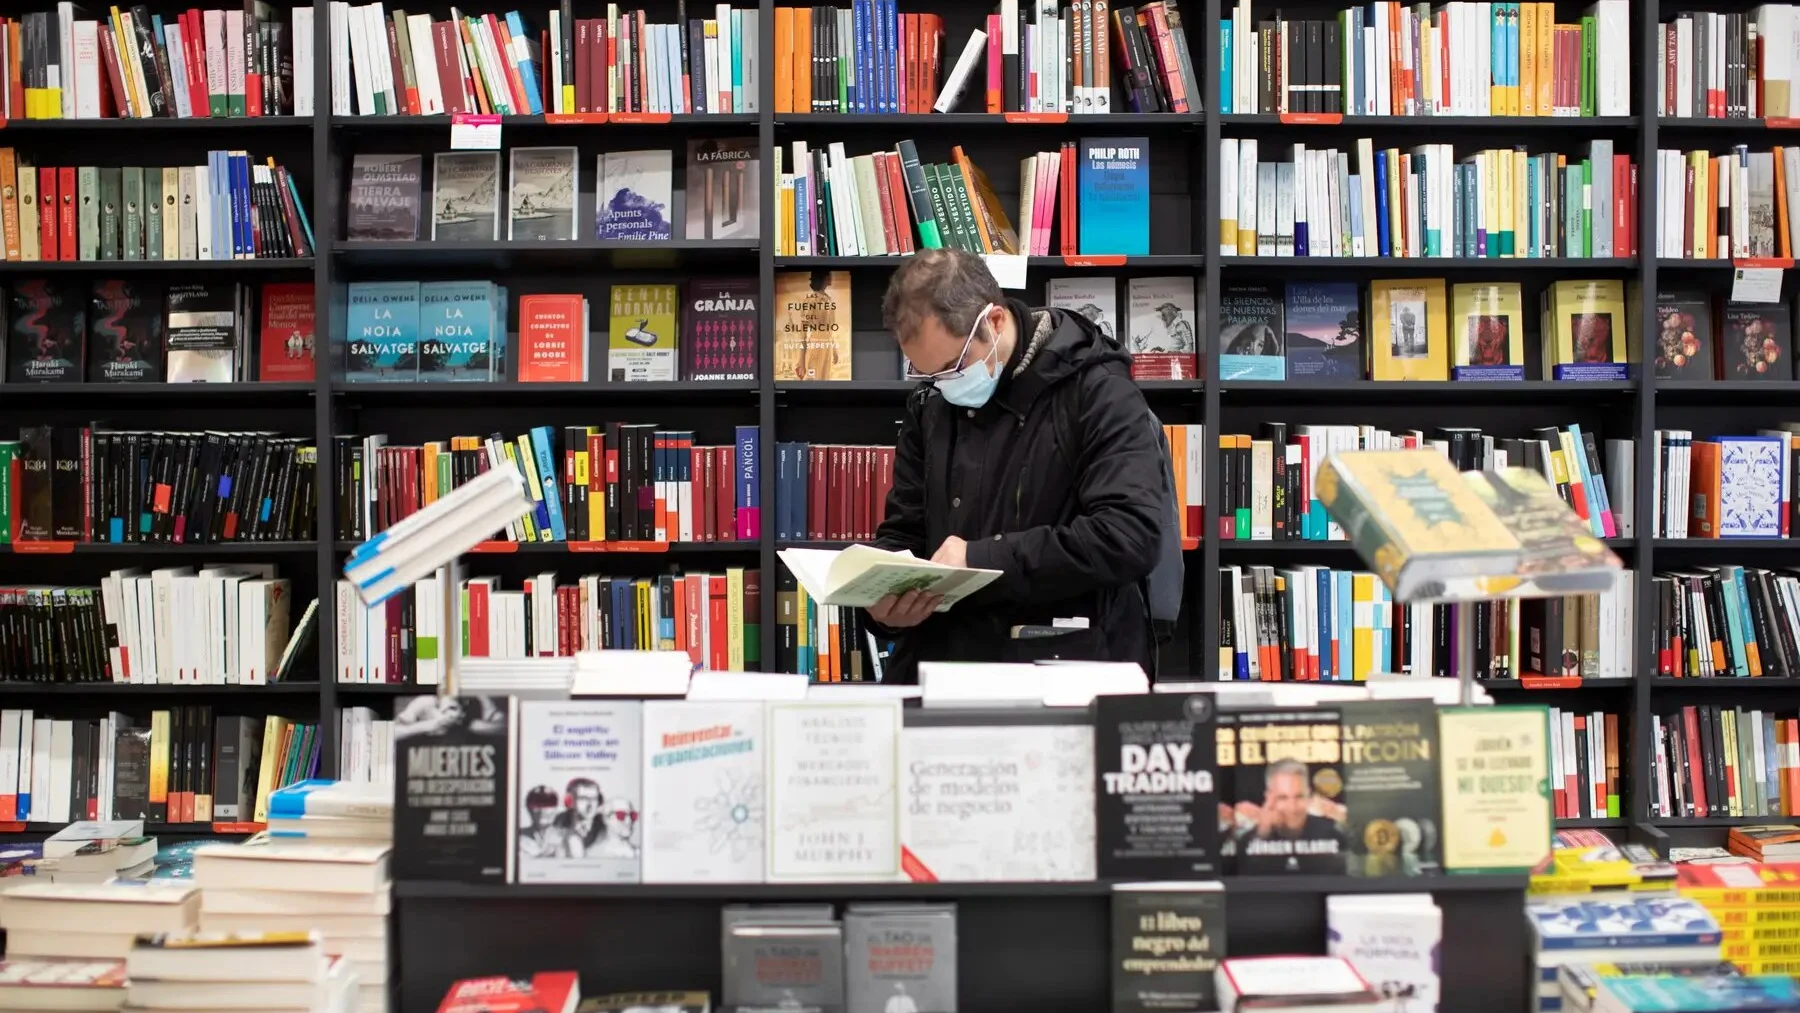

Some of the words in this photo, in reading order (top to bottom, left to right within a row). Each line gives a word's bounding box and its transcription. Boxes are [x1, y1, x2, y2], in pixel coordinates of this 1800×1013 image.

[697, 153, 709, 161] LA
[711, 150, 751, 161] FÁBRICA
[1089, 148, 1116, 160] PHILIP
[1118, 148, 1140, 160] ROTH
[363, 164, 402, 173] ROBERT
[1092, 160, 1105, 169] Las
[363, 173, 416, 182] OLMSTEAD
[358, 186, 402, 197] TIERRA
[357, 196, 411, 207] SALVAJE
[932, 187, 948, 226] VESTIDO
[945, 186, 962, 225] VESTIDO
[958, 186, 975, 225] VESTIDO
[607, 209, 642, 220] Apunts
[606, 220, 653, 231] personals
[942, 225, 950, 236] EL
[956, 225, 964, 236] EL
[969, 225, 976, 235] EL
[648, 231, 669, 240] Pine
[353, 295, 378, 303] DELIA
[383, 294, 415, 303] OWENS
[425, 295, 449, 303] DELIA
[454, 294, 486, 302] OWENS
[613, 288, 672, 302] GENTE
[1292, 295, 1311, 304] L'illa
[1312, 295, 1322, 303] de
[1323, 295, 1334, 303] les
[694, 299, 755, 312] GRANJA
[788, 302, 837, 311] FUENTES
[1233, 297, 1274, 306] SILENCIO
[446, 308, 463, 319] LA
[613, 302, 672, 316] NORMAL
[1220, 306, 1231, 314] DE
[1233, 306, 1277, 315] NUESTRAS
[1292, 304, 1316, 313] dones
[1317, 303, 1330, 313] del
[374, 308, 392, 320] LA
[1228, 316, 1269, 324] PALABRAS
[363, 326, 401, 337] NOIA
[435, 325, 473, 336] NOIA
[784, 323, 840, 333] SILENCIO
[350, 343, 414, 355] SALVATGE
[423, 342, 486, 354] SALVATGE
[533, 350, 566, 359] MOORE
[31, 360, 59, 368] Haruki
[110, 361, 138, 369] Haruki
[25, 368, 64, 376] Murakami
[104, 368, 143, 377] Murakami
[694, 373, 725, 381] JOANNE
[744, 437, 754, 479] PANCOL
[24, 460, 47, 470] 1Q84
[56, 460, 78, 471] 1Q84
[553, 725, 564, 734] El
[567, 724, 610, 736] espíritu
[543, 738, 560, 747] del
[564, 737, 601, 747] mundo
[662, 725, 732, 749] Reinventar
[544, 750, 581, 761] Silicon
[585, 749, 617, 761] Valley
[651, 738, 753, 768] organizaciones
[1343, 738, 1430, 764] ITCOIN
[407, 745, 496, 778] MUERTES
[1120, 743, 1192, 773] DAY
[909, 757, 1018, 777] Generación
[909, 777, 931, 795] de
[939, 776, 1019, 795] modelos
[1103, 771, 1213, 794] TRADING
[909, 796, 931, 814] de
[936, 801, 1012, 820] negocio
[799, 832, 849, 846] JOHN
[794, 849, 874, 862] MURPHY
[1140, 915, 1156, 931] El
[1157, 911, 1202, 931] libro
[1132, 936, 1185, 956] negro
[1187, 935, 1210, 950] del
[868, 959, 934, 972] BUFFETT
[1122, 955, 1217, 975] emprendedor
